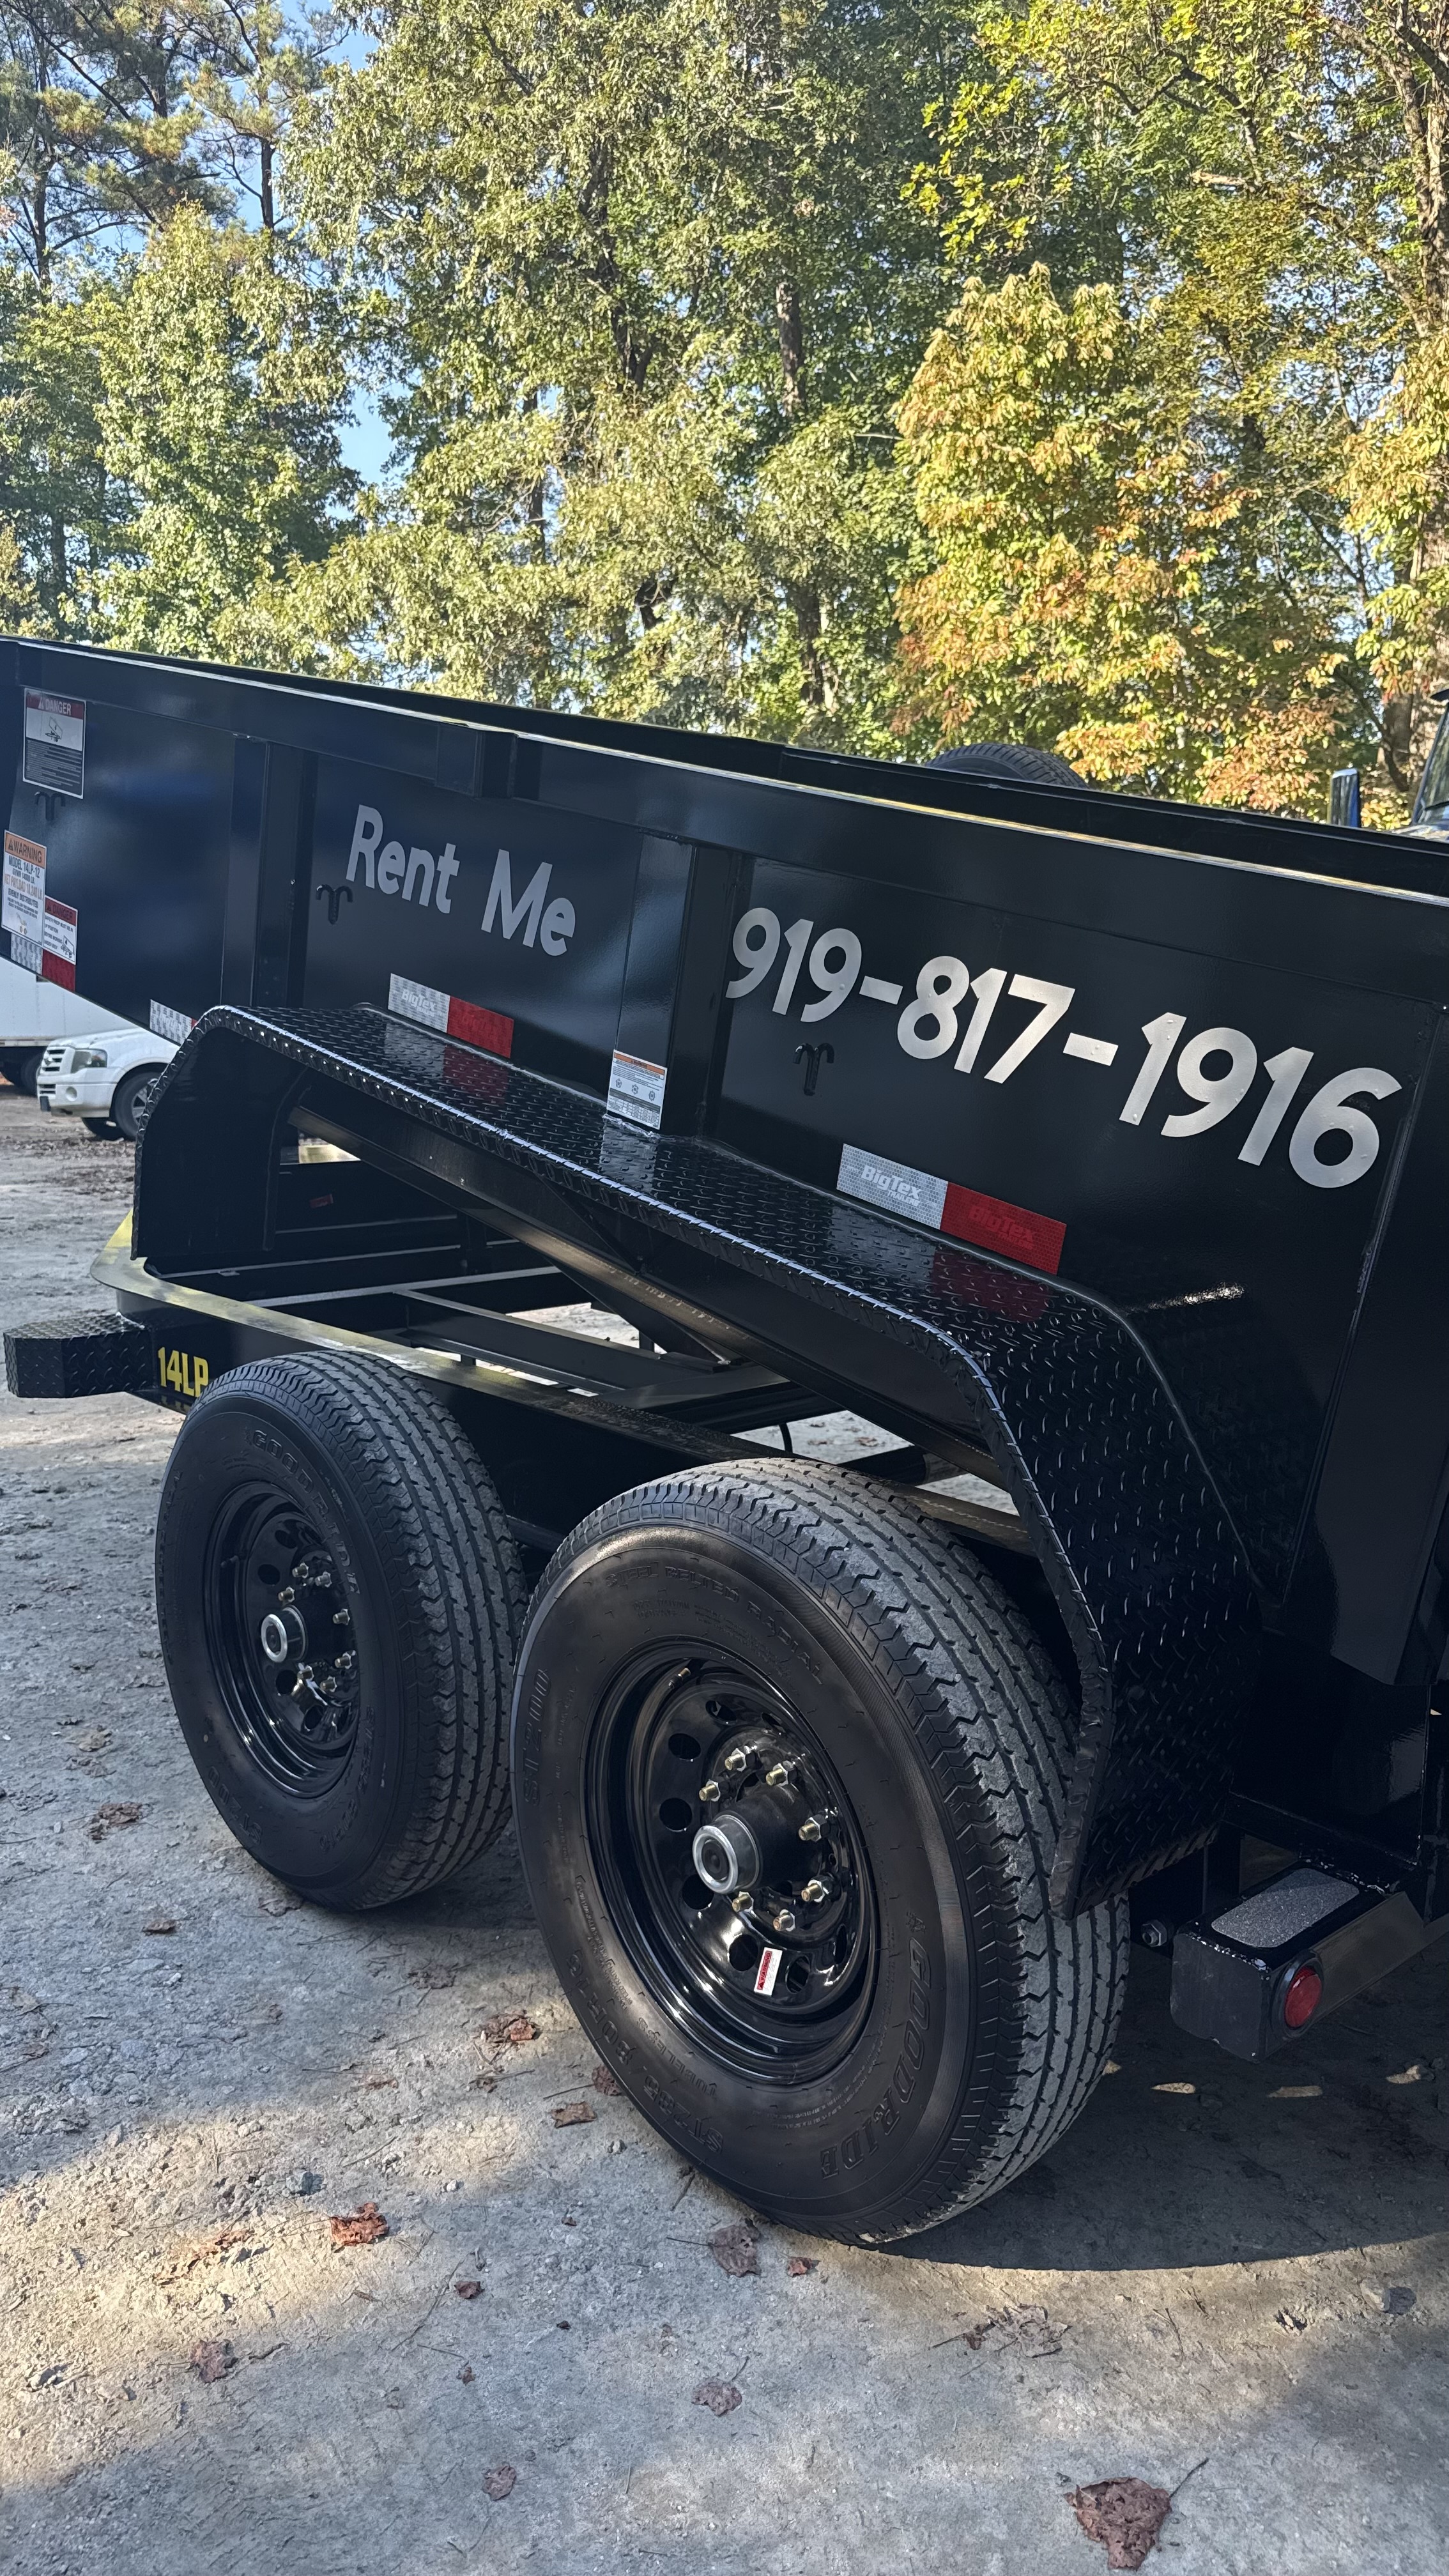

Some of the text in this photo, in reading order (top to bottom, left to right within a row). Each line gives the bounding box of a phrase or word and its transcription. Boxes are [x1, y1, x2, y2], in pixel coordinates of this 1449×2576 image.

[46, 698, 72, 716] DANGER
[9, 855, 40, 878] MODEL 14LP-12
[13, 839, 42, 863] WARNING
[346, 804, 576, 956] Rent Me
[52, 903, 73, 921] DANGER
[401, 988, 436, 1011] BigTex
[726, 907, 1402, 1188] 919-817-1916
[861, 1165, 922, 1200] BigTex
[887, 1189, 921, 1208] TRAILERS
[968, 1205, 1034, 1243] BigTex
[158, 1347, 209, 1398] 14LP
[252, 1429, 361, 1595] GOODRIDE
[606, 1565, 659, 1588] STEEL
[664, 1566, 740, 1604] BELTED
[746, 1600, 824, 1685] RADIAL
[523, 1668, 552, 1807] ST200
[208, 1765, 263, 1846] ST200
[636, 2016, 716, 2096] TUBELESS
[820, 1936, 931, 2180] GOODRIDE
